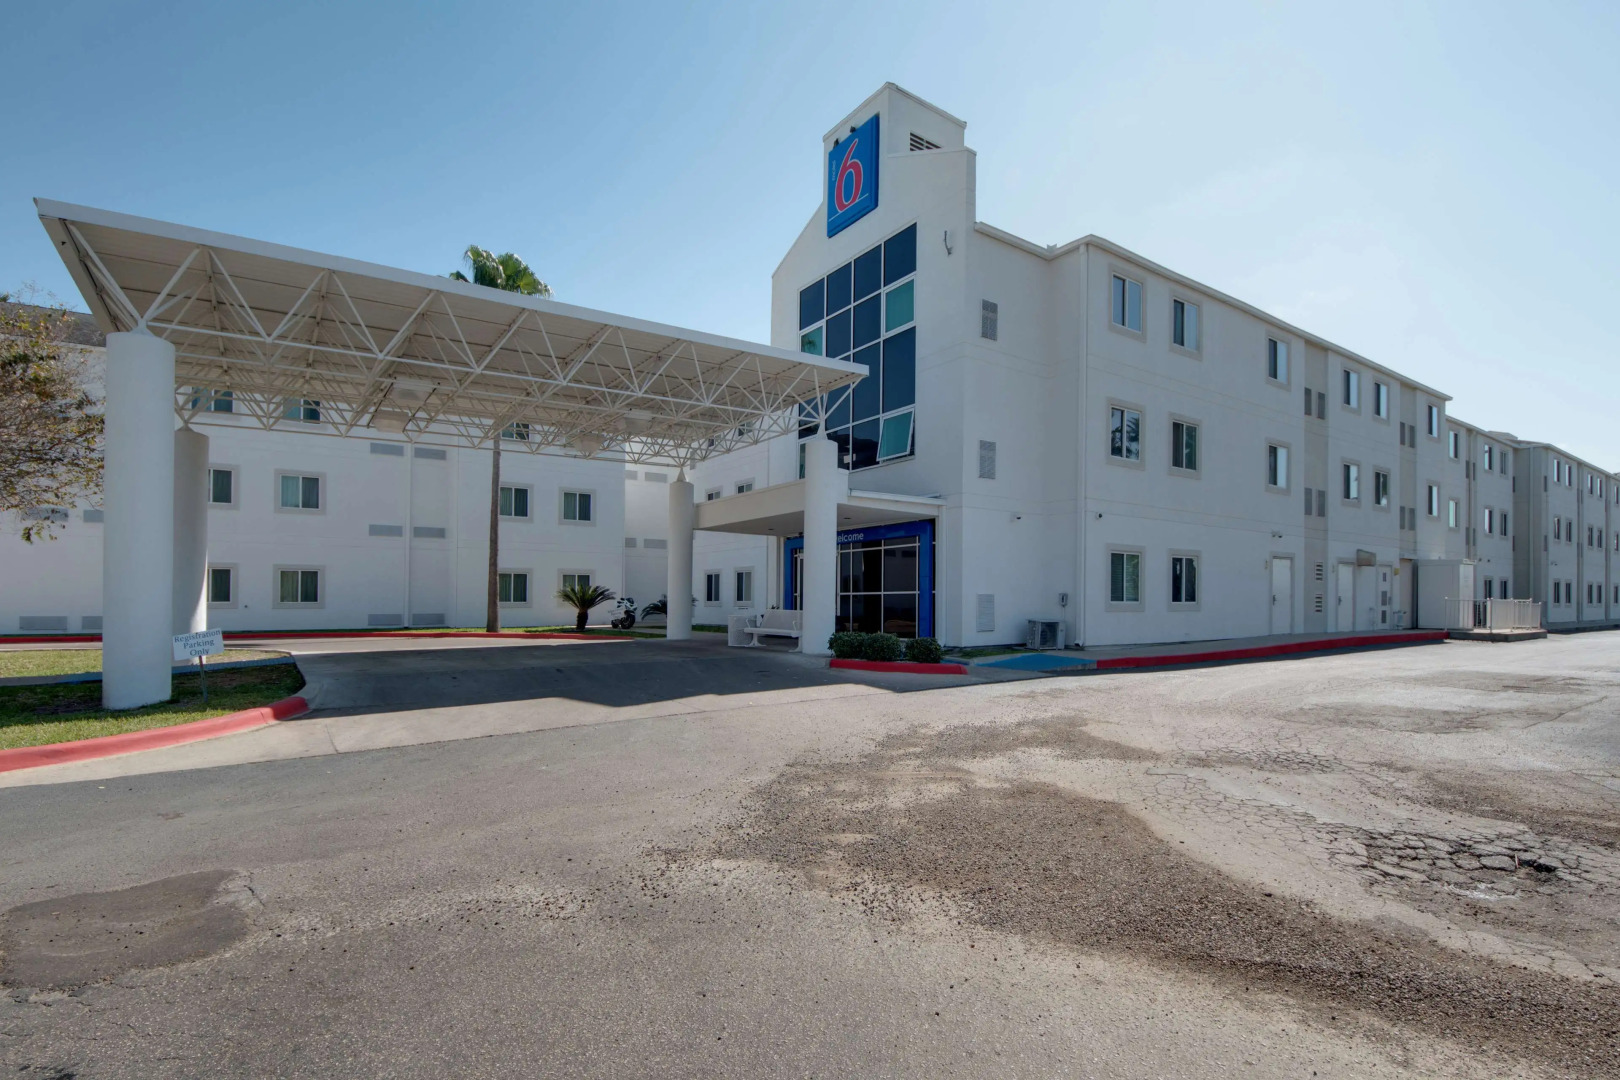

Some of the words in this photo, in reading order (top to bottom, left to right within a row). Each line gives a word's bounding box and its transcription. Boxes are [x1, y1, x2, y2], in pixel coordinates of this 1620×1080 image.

[835, 138, 864, 213] 6
[837, 532, 864, 542] elcome
[174, 630, 221, 643] Registration
[183, 639, 215, 649] Parking
[189, 648, 210, 656] Only
